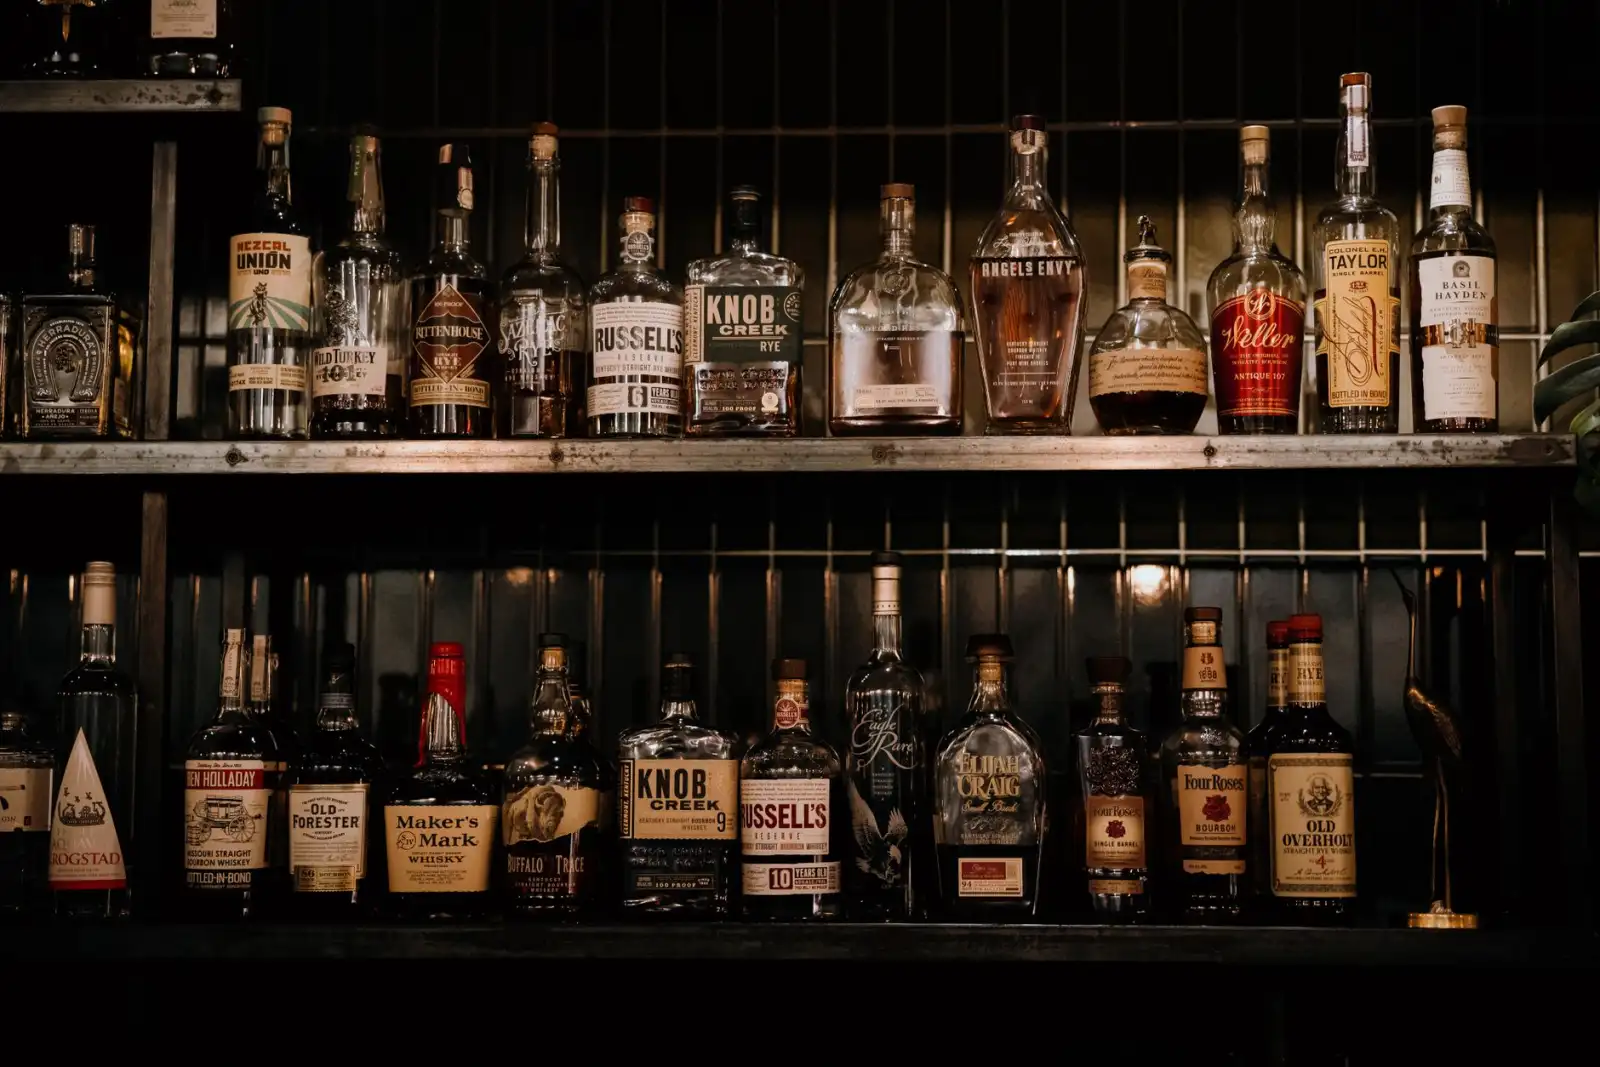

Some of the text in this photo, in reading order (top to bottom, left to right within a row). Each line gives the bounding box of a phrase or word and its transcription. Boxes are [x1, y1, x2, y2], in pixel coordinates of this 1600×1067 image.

[237, 251, 291, 270] UNIÓN
[1329, 254, 1387, 270] TAYLOR
[1038, 260, 1072, 276] ENVY
[1442, 281, 1480, 290] BASIL
[1436, 291, 1486, 300] HAYDEN
[707, 294, 774, 324] KNOB
[416, 326, 484, 340] RITTENHOUSE
[720, 324, 788, 336] CREEK
[1222, 315, 1296, 352] Weller
[595, 326, 682, 354] RUSSELL'S
[760, 341, 780, 352] RYE
[332, 348, 376, 364] TURKEY
[322, 364, 356, 382] 101
[1234, 372, 1286, 380] ANTIQUE 107
[632, 388, 644, 407] 6
[652, 388, 670, 397] YEARS
[1332, 390, 1386, 399] BOTTLED IN BOND
[1198, 670, 1218, 680] 1888
[1271, 673, 1288, 684] RY
[1297, 668, 1322, 680] RYE
[858, 731, 917, 769] Rare
[958, 752, 1020, 778] ELIJAH
[203, 771, 256, 787] HOLLADAY
[638, 768, 706, 799] KNOB
[1184, 774, 1244, 790] Four Roses
[957, 775, 1020, 800] CRAIG
[311, 803, 336, 815] OLD
[650, 800, 720, 810] CREEK
[293, 814, 359, 829] FORESTER
[396, 815, 479, 829] Maker's
[717, 812, 726, 832] 9
[1196, 824, 1236, 832] BOURBON
[1306, 820, 1336, 833] OLD
[418, 833, 478, 848] Mark
[755, 832, 800, 840] RESERVE
[1282, 833, 1352, 847] OVERHOLT
[50, 852, 120, 866] ROGSTAD
[216, 850, 252, 858] STRAIGHT
[408, 856, 465, 864] WHISKY
[218, 858, 251, 866] WHISKEY
[507, 852, 584, 875] BUFFALO TRACE
[1316, 855, 1326, 869] 4
[771, 869, 790, 888] 10
[796, 868, 816, 878] YEARS
[961, 880, 972, 888] 94
